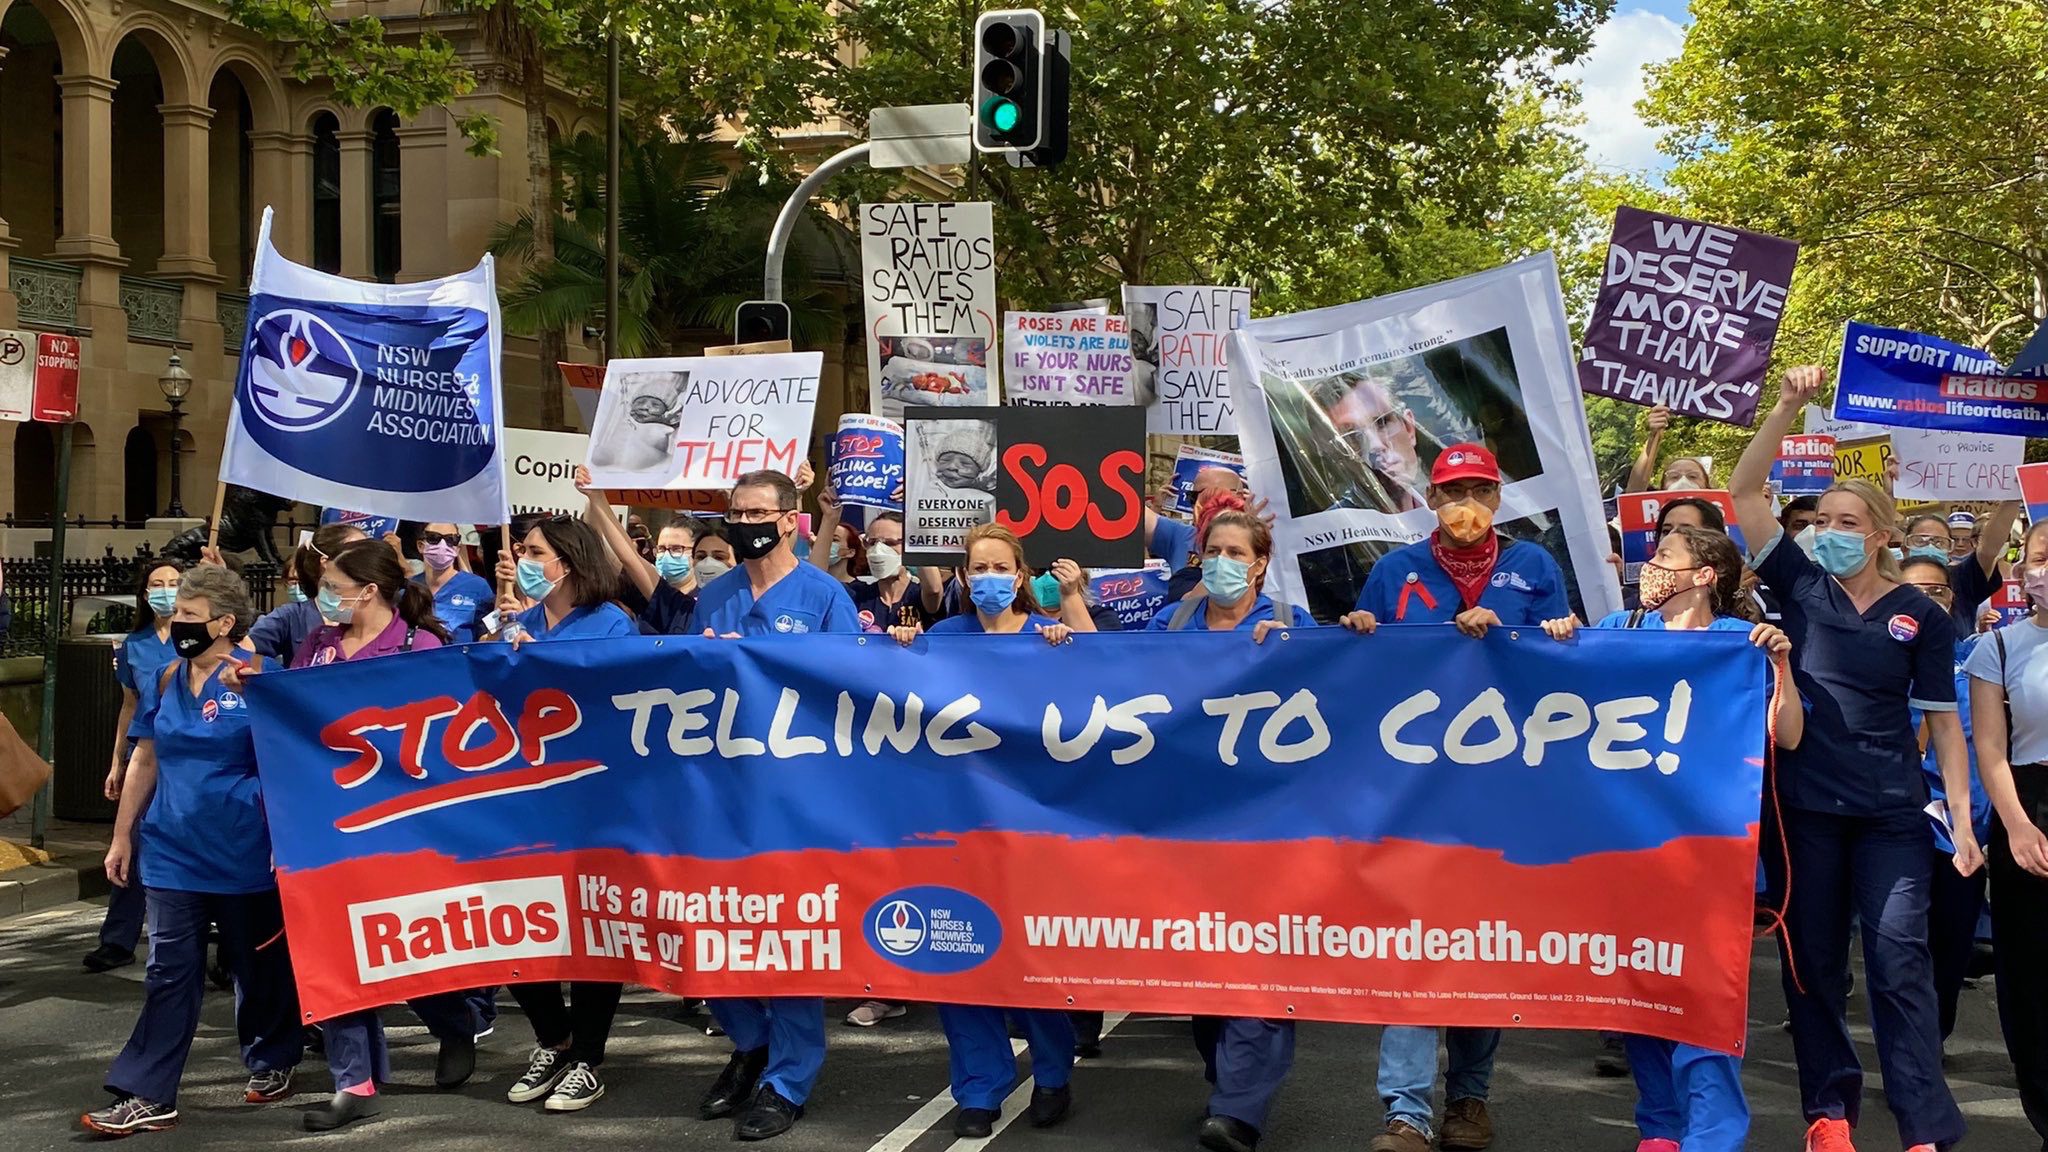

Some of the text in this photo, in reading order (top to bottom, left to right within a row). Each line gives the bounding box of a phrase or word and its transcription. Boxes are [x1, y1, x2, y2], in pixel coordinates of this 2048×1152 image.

[868, 203, 957, 237] SAFE
[890, 237, 992, 271] RATIOS
[1652, 220, 1739, 266] WE
[872, 269, 974, 301] SAVES
[1606, 243, 1787, 320] DESERVE
[892, 302, 976, 334] THEM
[1162, 290, 1250, 331] SAFE
[1612, 291, 1749, 349] MORE
[1018, 317, 1063, 331] ROSES
[1070, 318, 1096, 332] ARE
[51, 340, 68, 353] NO
[377, 344, 431, 367] NSW
[1024, 334, 1129, 351] VIOLETS ARE BLU
[1609, 320, 1720, 378] THAN
[1855, 335, 1950, 368] SUPPORT
[39, 355, 79, 370] STOPPING
[1014, 351, 1133, 373] IF YOUR NURS
[1317, 360, 1356, 376] system
[1359, 348, 1405, 366] remains
[377, 367, 480, 395] NURSES &
[686, 376, 818, 406] ADVOCATE
[1023, 374, 1124, 395] ISN'T SAFE
[1163, 370, 1230, 400] SAVE
[1581, 346, 1759, 419] "THANKS"
[1946, 375, 2038, 400] Ratios
[373, 385, 480, 420] MIDWIVES'
[366, 410, 491, 446] ASSOCIATION
[708, 413, 765, 438] FOR
[840, 434, 884, 453] STOP
[1781, 438, 1835, 456] Ratios
[1937, 444, 1950, 453] TO
[677, 438, 798, 480] THEM
[882, 463, 902, 476] US
[1782, 460, 1796, 468] It's
[1804, 460, 1831, 468] matter
[844, 475, 889, 490] COPE!
[1906, 461, 1958, 489] SAFE
[1966, 462, 2012, 490] CARE
[918, 499, 984, 509] EVERYONE
[919, 517, 980, 527] DESERVES
[909, 535, 965, 546] SAFE RAT
[1303, 531, 1338, 547] NSW
[1341, 526, 1380, 540] Health
[1101, 577, 1144, 596] STOP
[1146, 595, 1164, 607] US
[320, 679, 1692, 788] STOP TELLING US TO COPE!
[578, 874, 839, 924] It's a matter of
[930, 909, 951, 919] NSW
[930, 920, 973, 931] NURSES &
[361, 895, 560, 968] Ratios
[582, 917, 842, 972] LIFE or DEATH
[930, 930, 975, 942] MIDWIVES'
[1023, 911, 1684, 976] www.ratioslifeordeath.org.au
[930, 941, 985, 954] ASSOCIATION
[1055, 976, 1062, 985] by
[1093, 977, 1115, 985] General
[1338, 987, 1352, 995] NSW
[1353, 988, 1369, 996] 2017
[1371, 989, 1393, 998] Printed
[1394, 990, 1401, 999] by
[1453, 991, 1467, 999] Print
[1510, 992, 1532, 1000] Ground
[1617, 996, 1630, 1007] Way
[1654, 1002, 1669, 1012] NSW
